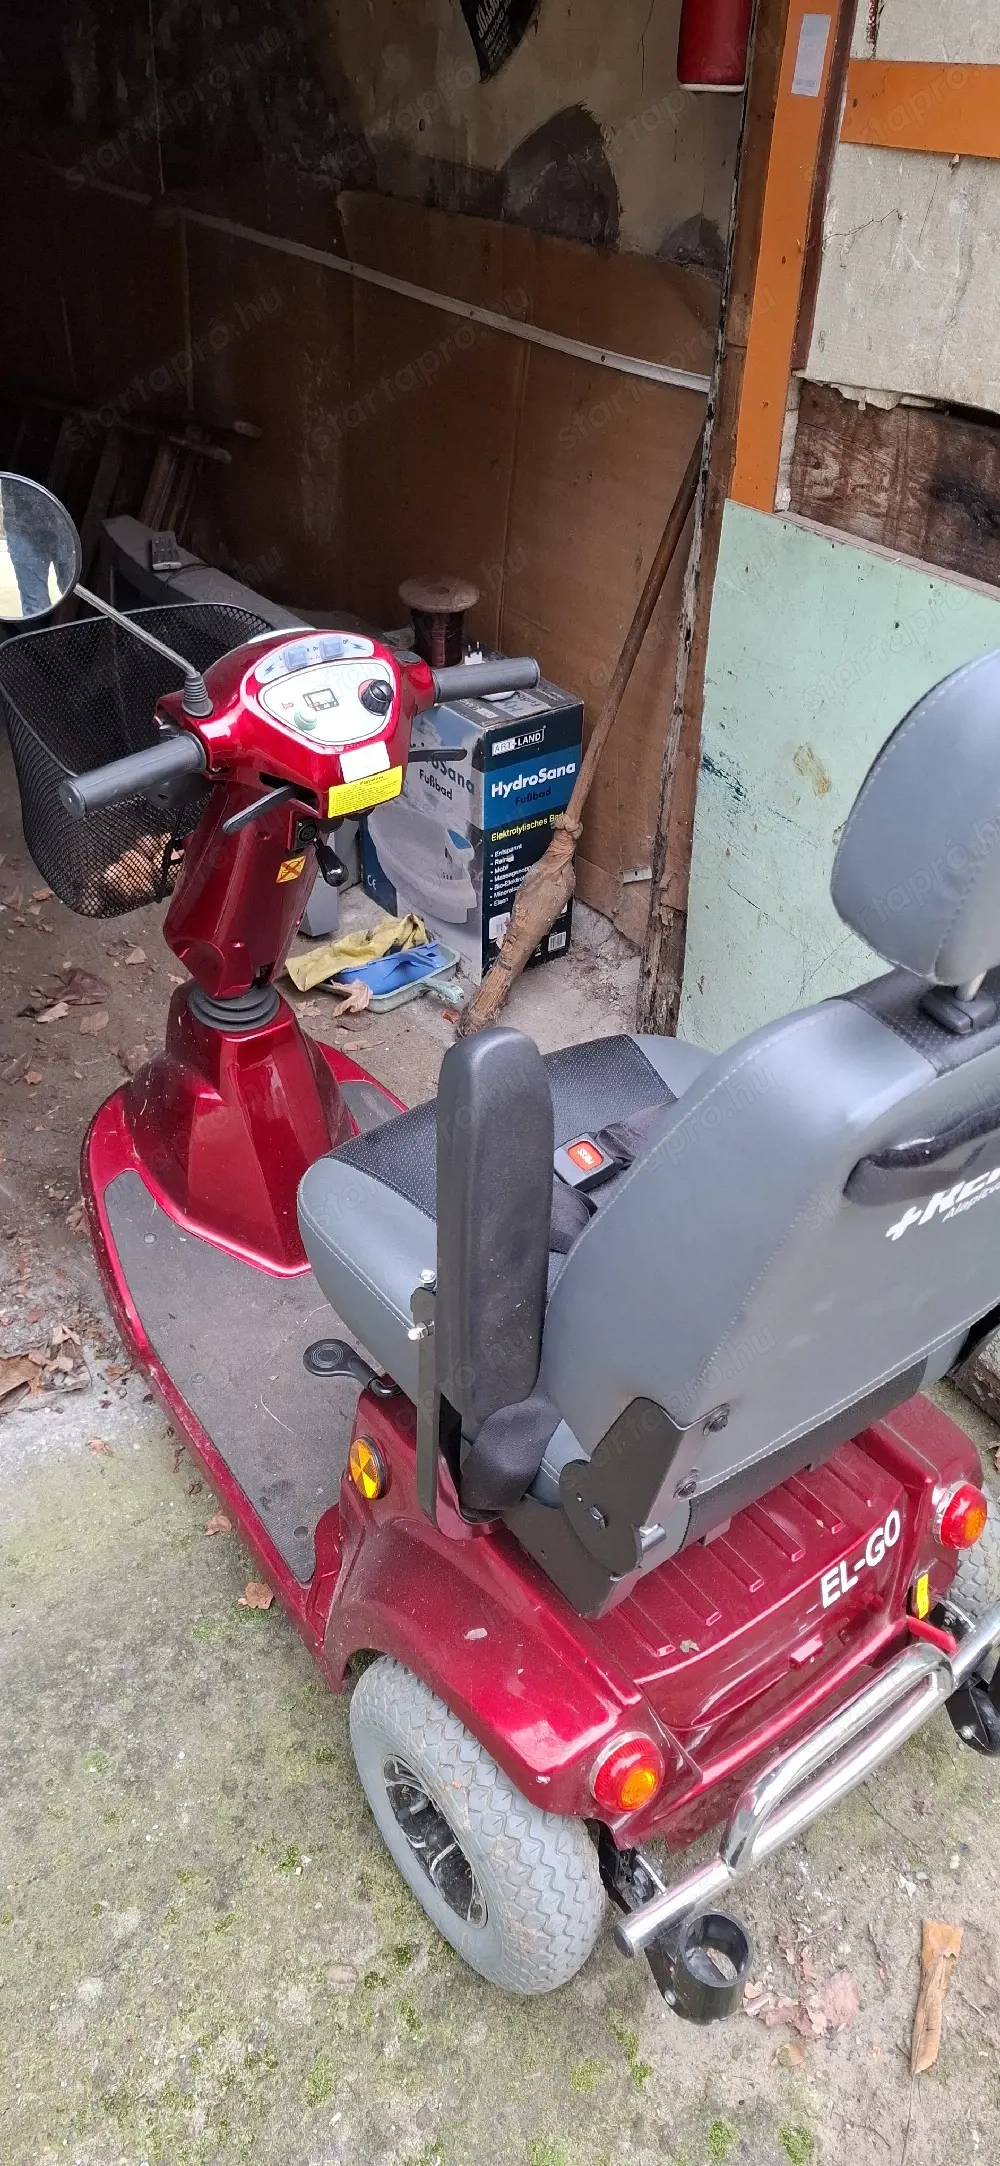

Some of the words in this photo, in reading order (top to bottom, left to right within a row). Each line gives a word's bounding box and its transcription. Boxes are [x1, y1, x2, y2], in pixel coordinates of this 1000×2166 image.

[419, 769, 453, 801] Fußbad
[491, 763, 576, 798] HydroSana
[515, 786, 552, 805] Fußbad
[491, 818, 548, 842] Elektrolytisches
[820, 1510, 900, 1609] EL-GO
